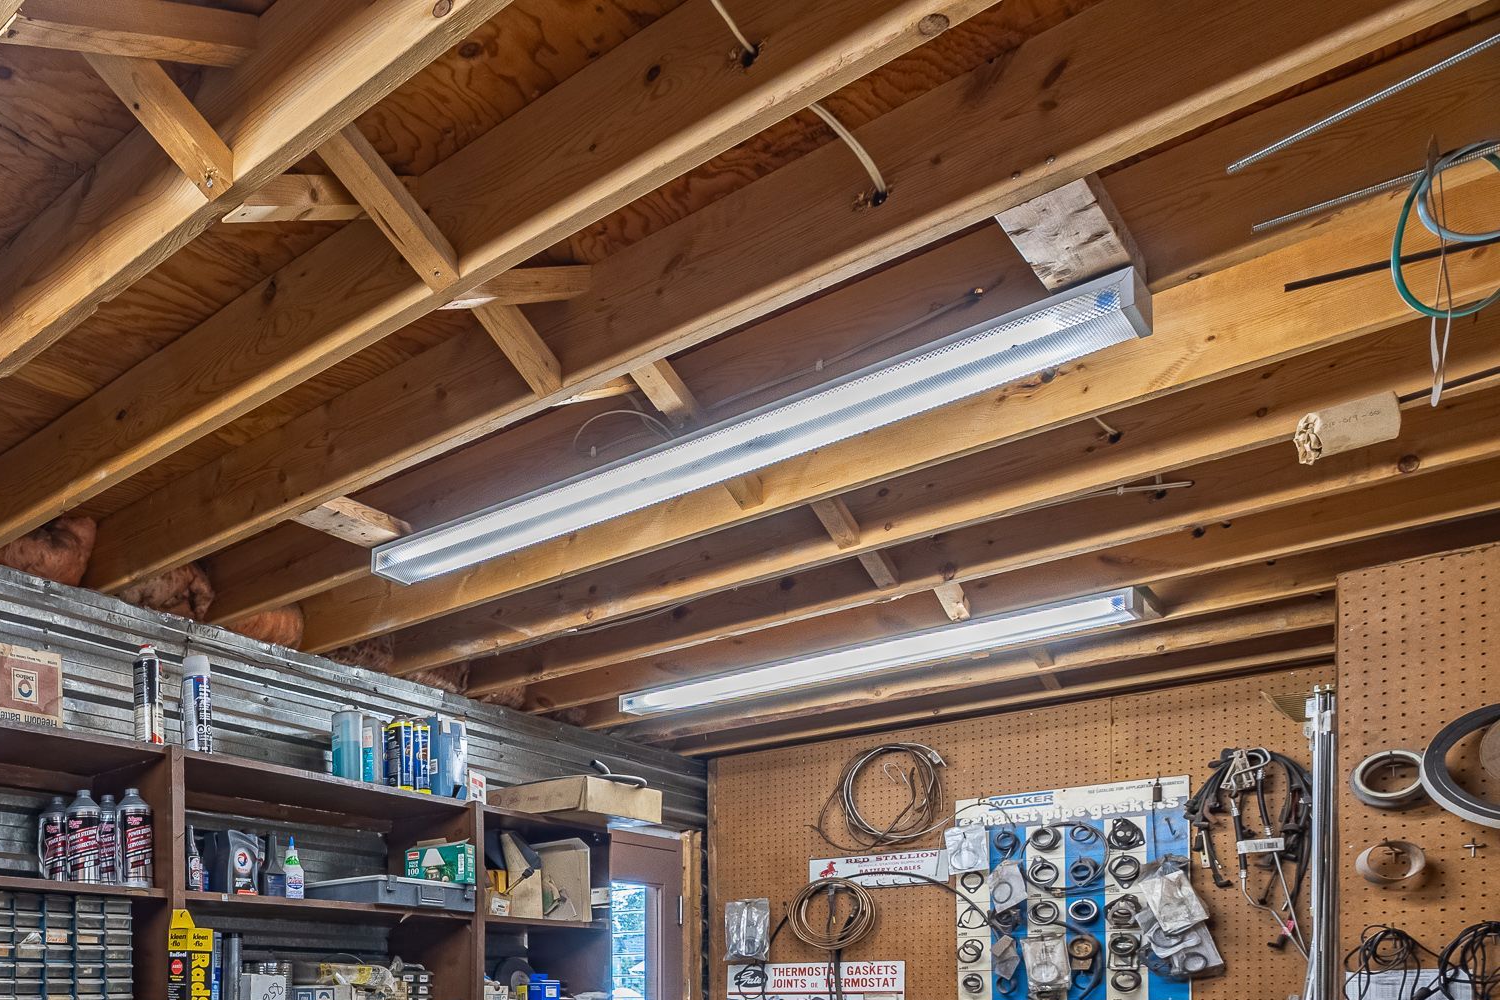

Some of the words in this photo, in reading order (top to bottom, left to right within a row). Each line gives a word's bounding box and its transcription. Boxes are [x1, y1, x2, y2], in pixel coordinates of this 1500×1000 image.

[25, 714, 58, 727] Freedom
[990, 795, 1053, 808] WALKER
[959, 808, 1037, 827] exhaust
[1045, 804, 1086, 823] pipe
[1087, 794, 1179, 819] gaskets
[875, 851, 938, 862] STALLION
[408, 868, 420, 876] 100
[893, 864, 922, 872] CABLES
[847, 965, 898, 976] GASKETS
[772, 978, 807, 988] JOINTS
[825, 977, 897, 988] THERMOSTAT
